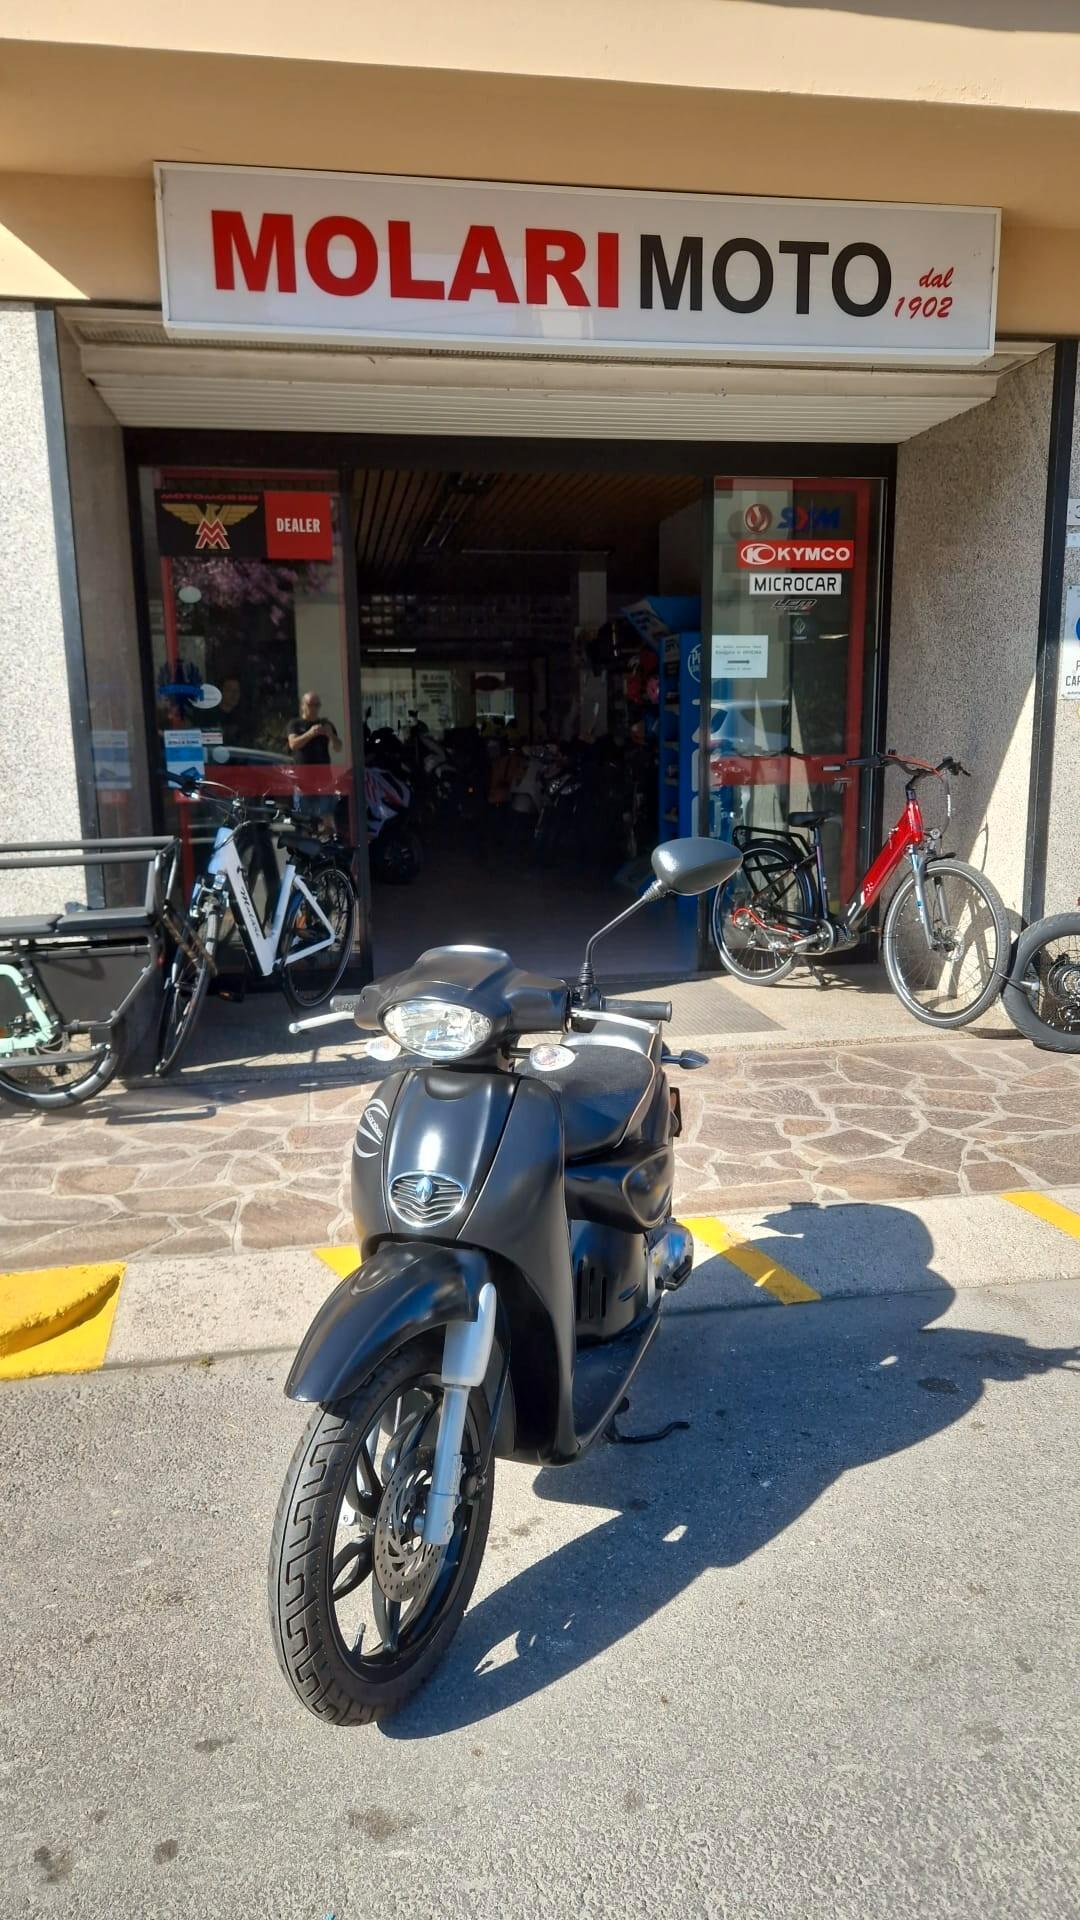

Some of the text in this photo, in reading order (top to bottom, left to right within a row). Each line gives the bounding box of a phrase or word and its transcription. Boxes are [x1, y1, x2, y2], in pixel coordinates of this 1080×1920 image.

[211, 210, 892, 318] MOLARI MOTO
[919, 266, 954, 288] dal
[894, 296, 953, 319] 1902
[276, 518, 321, 533] DEALER
[777, 547, 850, 561] KYMCO
[754, 576, 837, 592] MICROCAR
